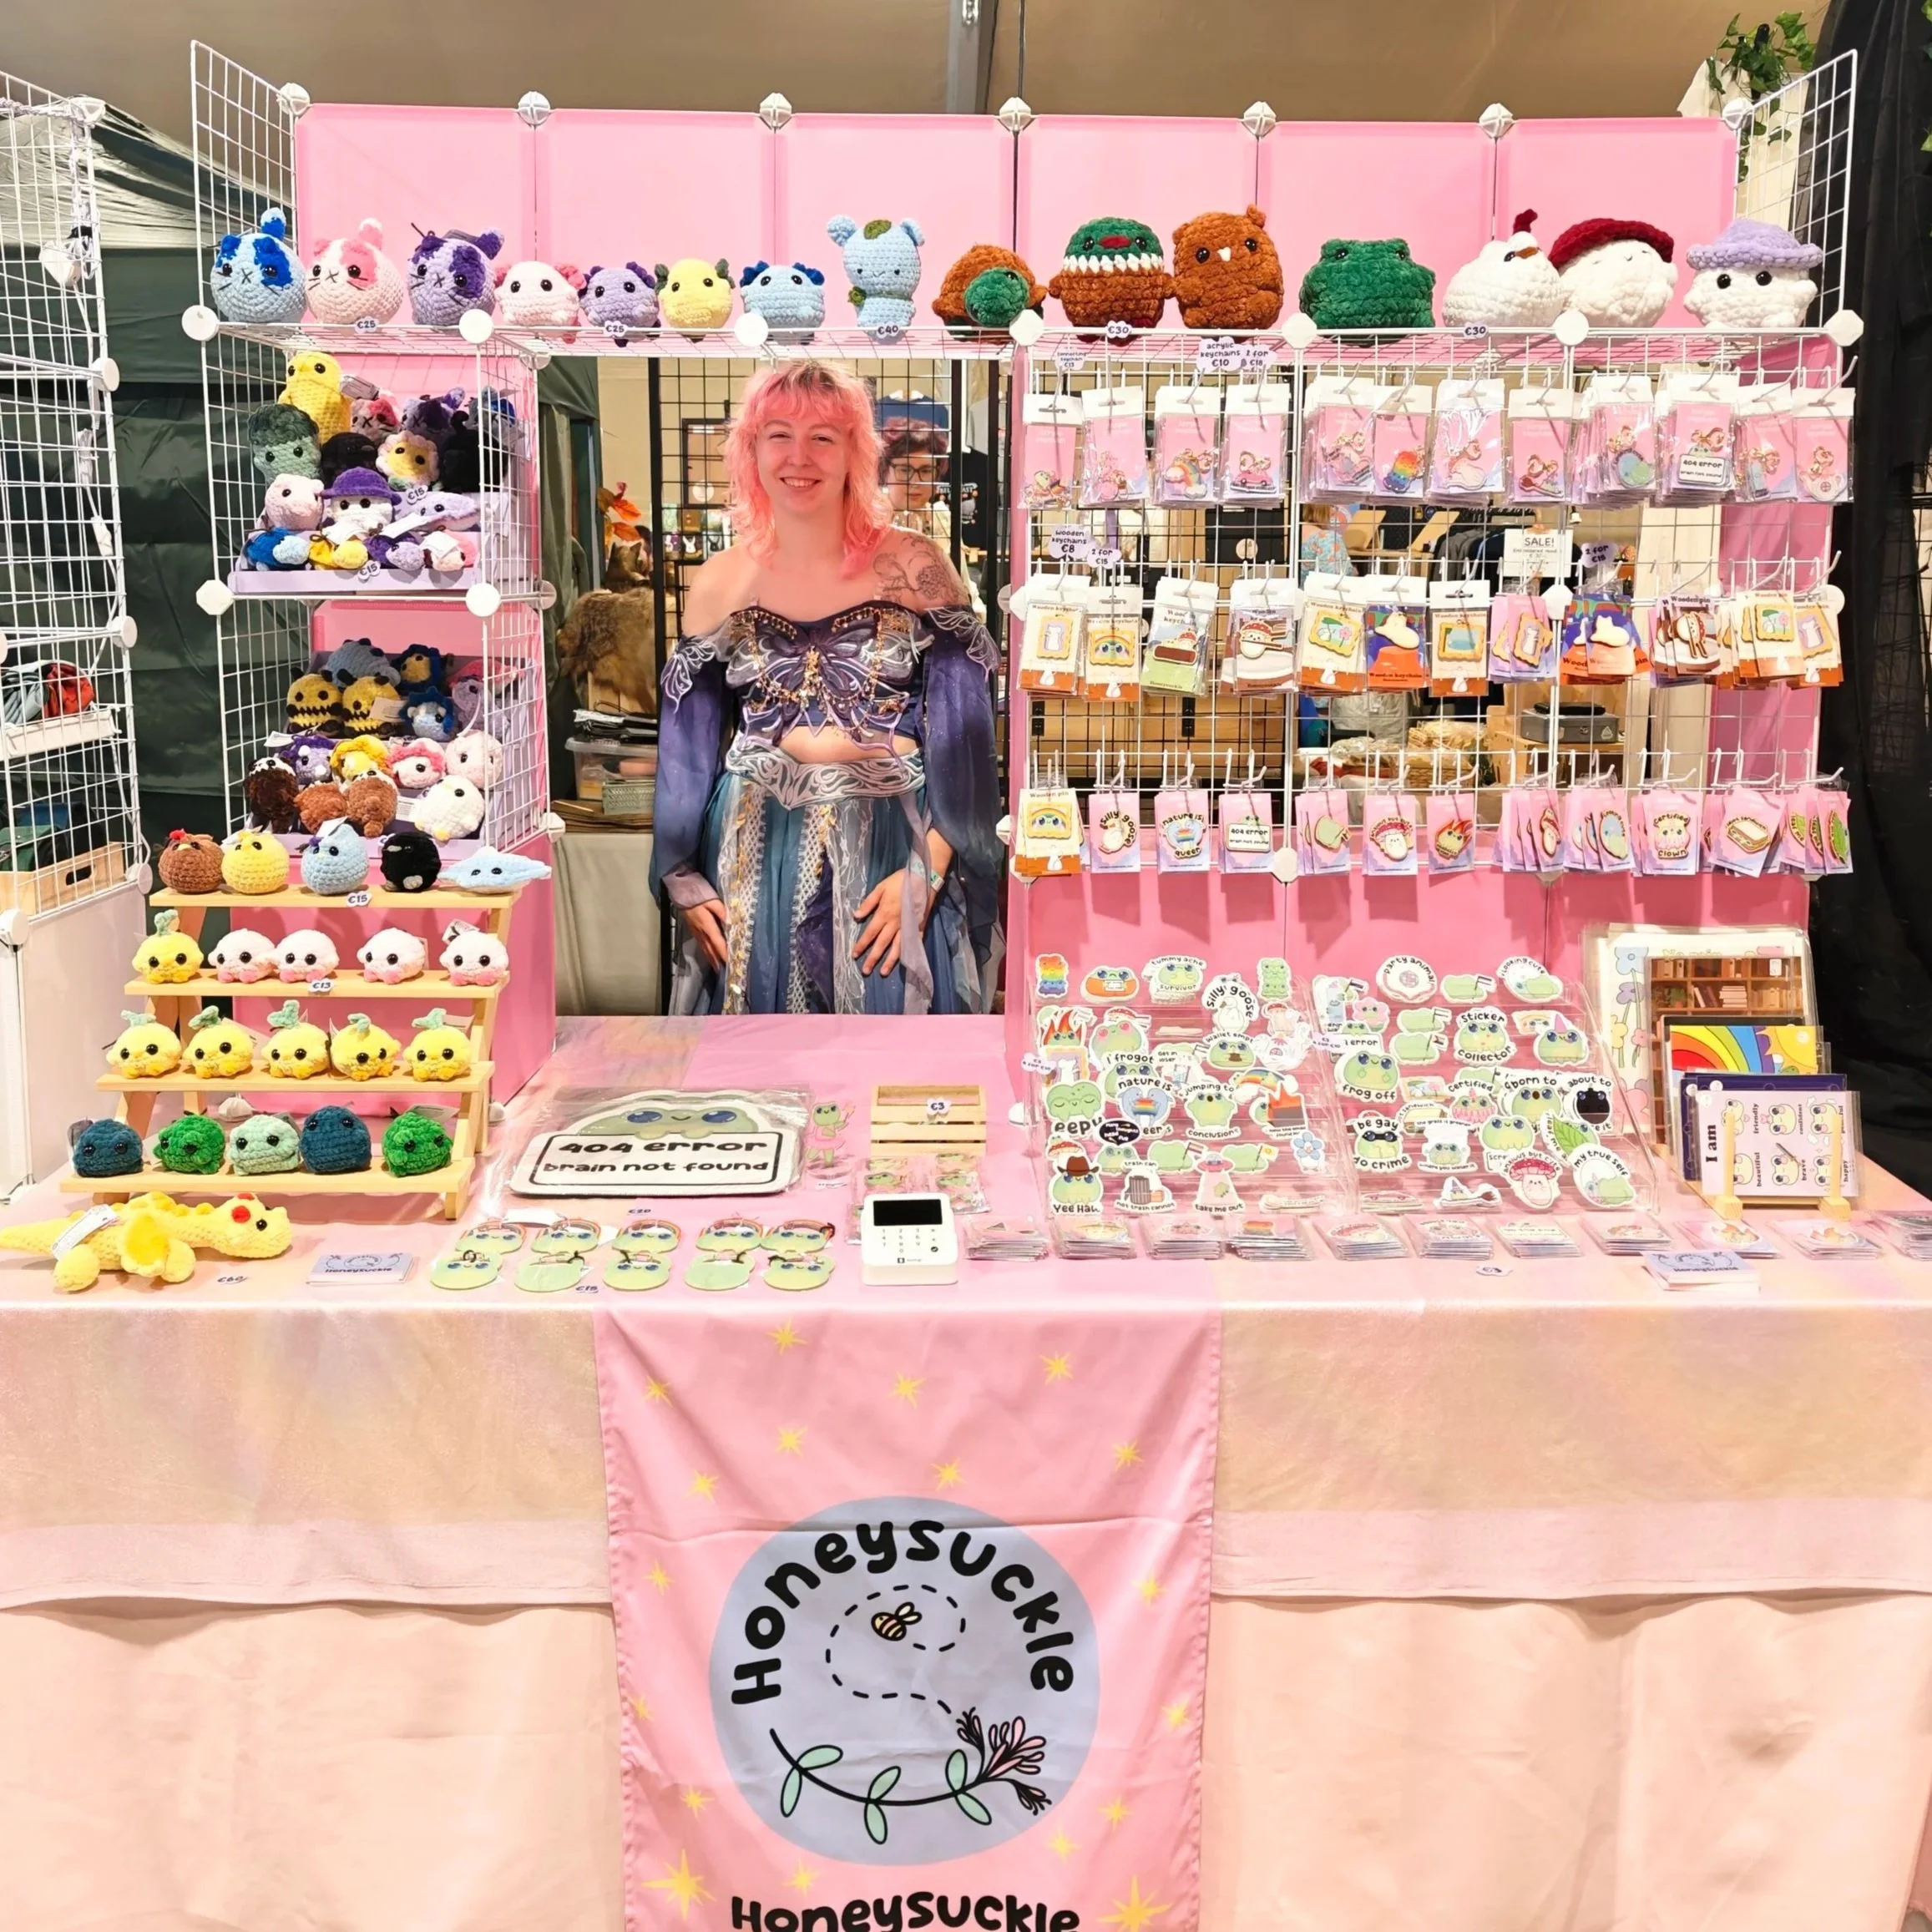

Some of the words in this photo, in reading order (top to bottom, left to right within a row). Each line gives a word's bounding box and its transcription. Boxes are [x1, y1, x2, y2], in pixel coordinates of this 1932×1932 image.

[357, 321, 376, 329] €25
[606, 325, 625, 333] €25
[877, 326, 898, 335] €40
[1464, 326, 1486, 336] €30
[407, 487, 425, 501] €15
[1061, 544, 1075, 552] €8
[1524, 537, 1555, 547] SALE!
[1593, 545, 1609, 554] for
[360, 563, 377, 576] €15
[1671, 595, 1699, 604] Wooden
[1162, 813, 1193, 826] nature
[1175, 847, 1201, 857] queer
[348, 894, 367, 903] €15
[1151, 957, 1181, 966] tummy
[1229, 985, 1255, 1019] goose
[1206, 1032, 1231, 1043] wallet
[1232, 1032, 1254, 1044] empt
[1115, 1053, 1154, 1065] frogot
[1118, 1078, 1161, 1089] nature
[1162, 1082, 1172, 1091] is
[1544, 1076, 1557, 1085] to
[1567, 1076, 1596, 1088] about
[1599, 1078, 1611, 1086] to
[1185, 1084, 1221, 1096] jumping
[1223, 1084, 1235, 1092] to
[1342, 1085, 1372, 1100] frog
[1375, 1090, 1395, 1100] off
[931, 1102, 945, 1110] €3
[1358, 1120, 1371, 1130] be
[1373, 1119, 1398, 1131] gay
[1707, 1125, 1717, 1151] am
[559, 1141, 634, 1153] 404
[644, 1140, 768, 1153] error
[544, 1161, 616, 1172] brain
[622, 1161, 677, 1171] not
[683, 1161, 769, 1171] found
[1372, 1156, 1409, 1170] crime
[1574, 1154, 1586, 1168] my
[1588, 1150, 1611, 1161] true
[1612, 1159, 1629, 1176] self
[1053, 1204, 1075, 1212] Yee
[731, 1520, 1075, 1705] Honeysuckle
